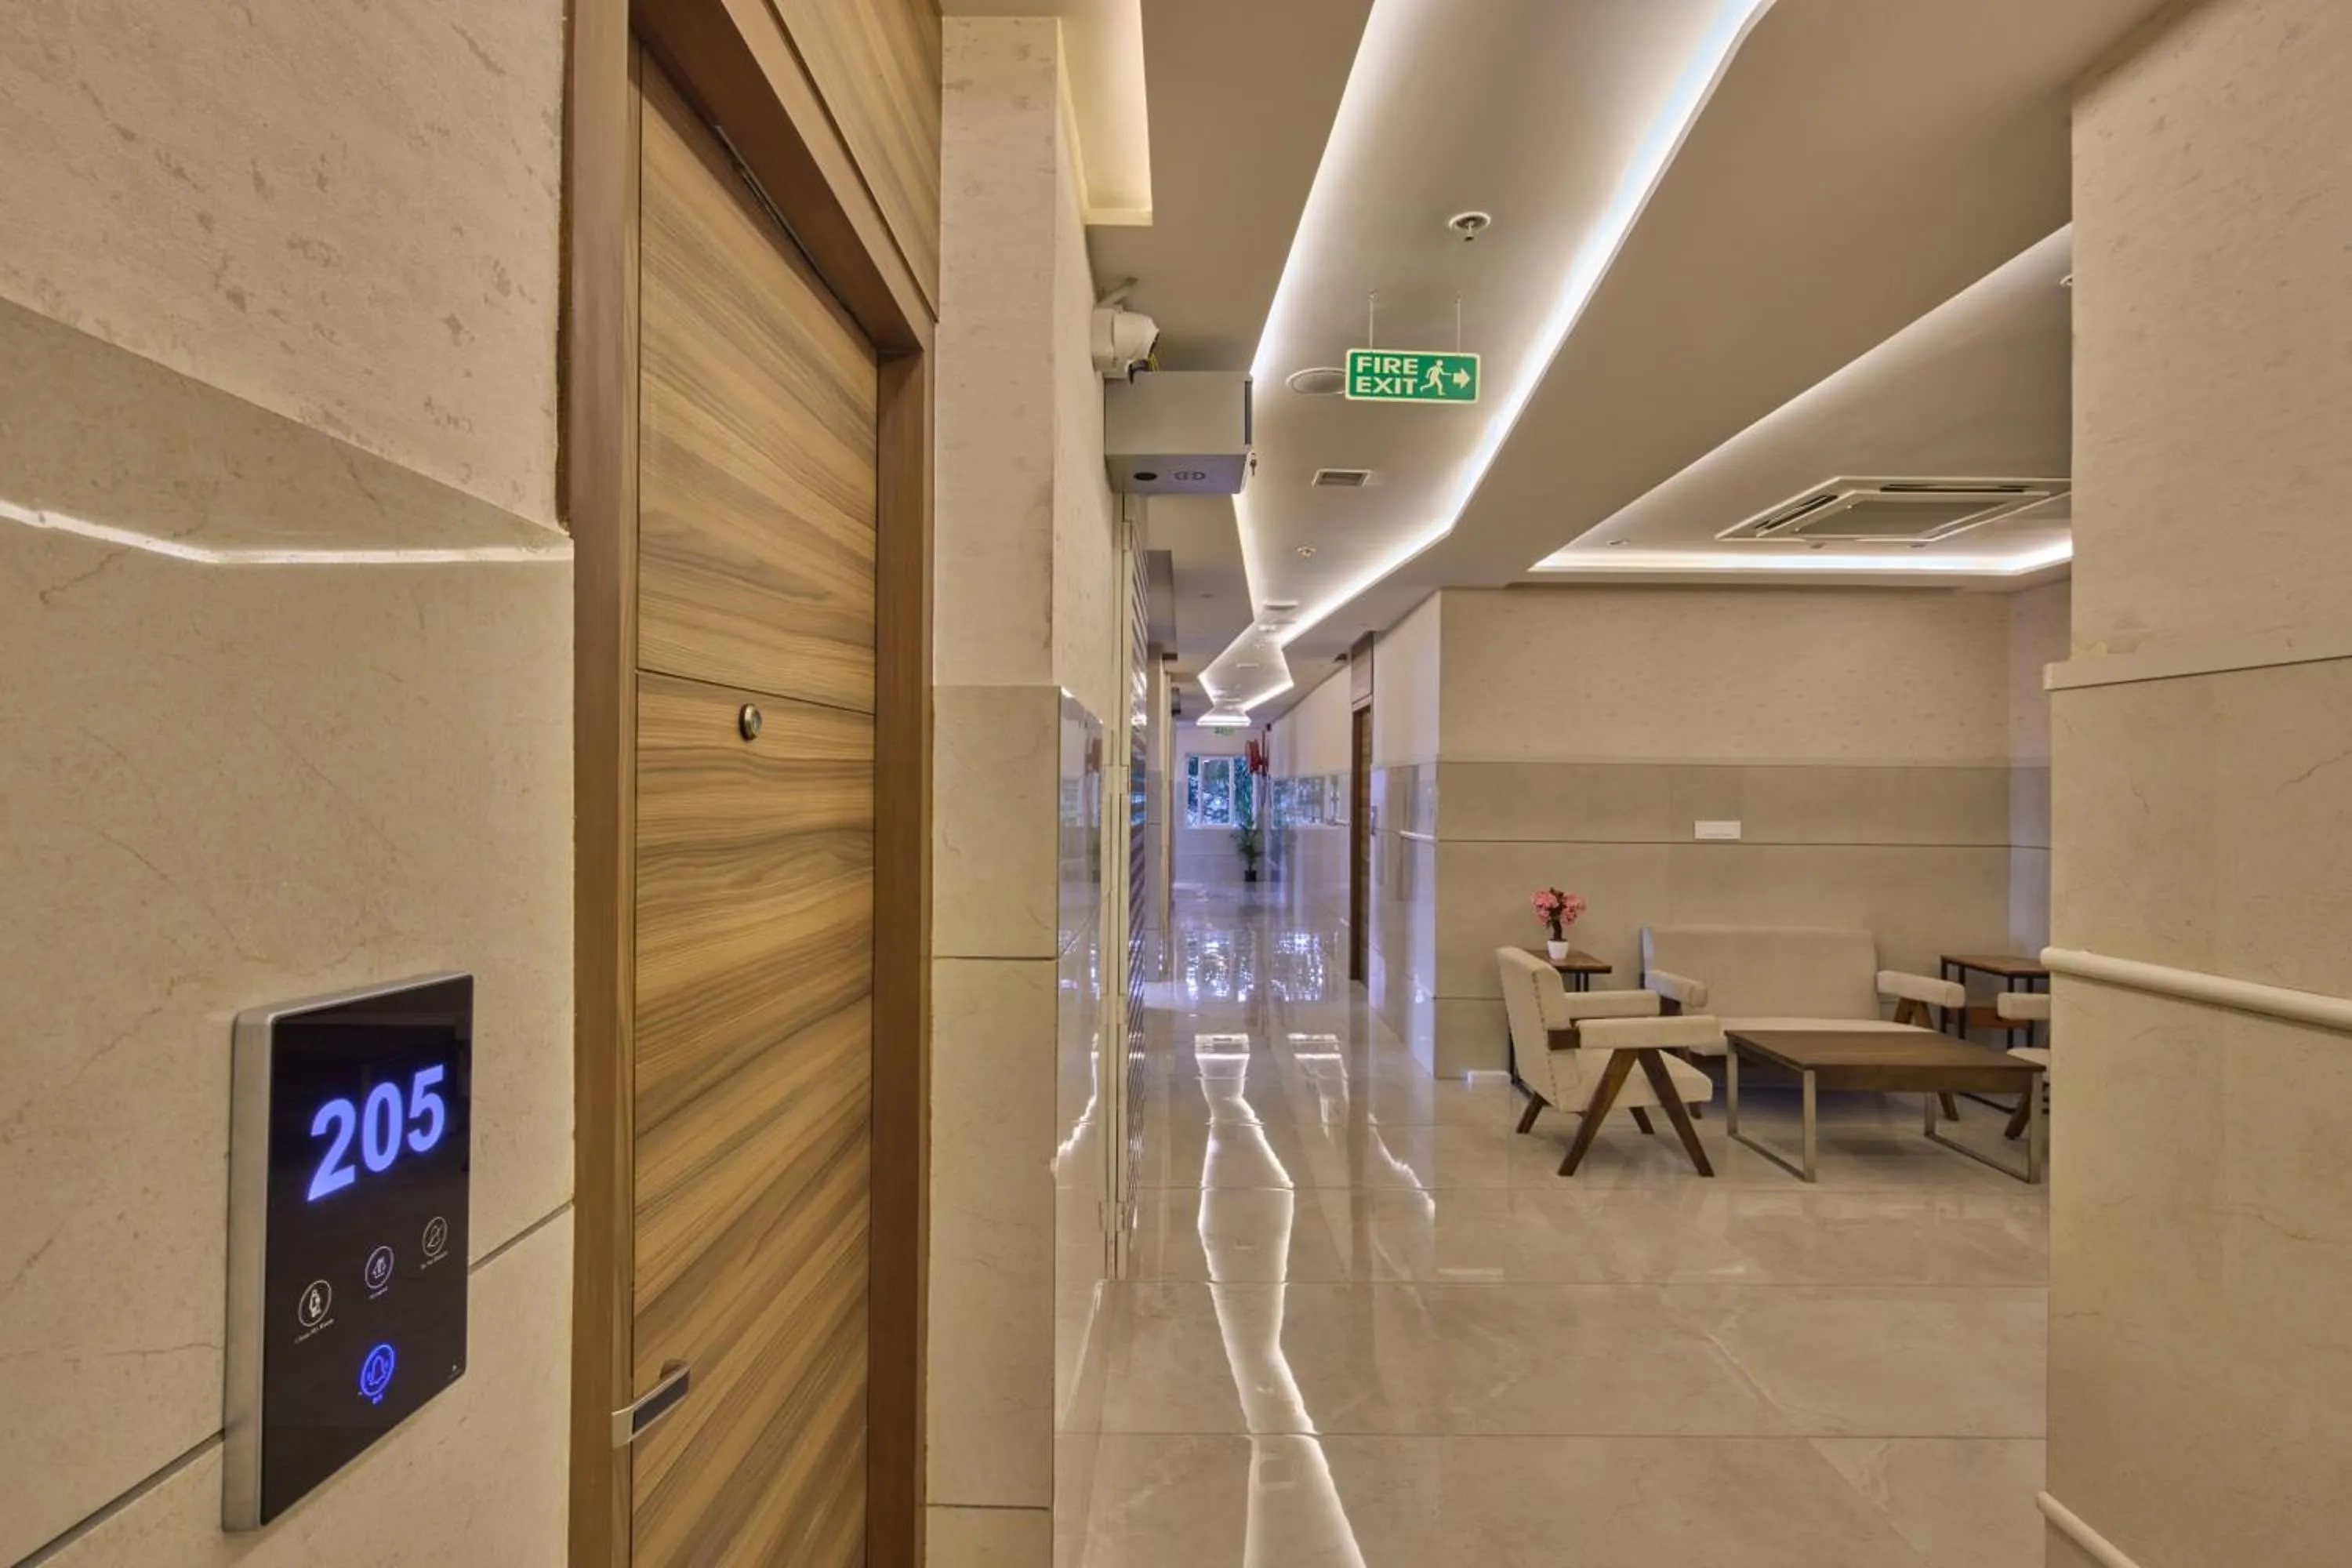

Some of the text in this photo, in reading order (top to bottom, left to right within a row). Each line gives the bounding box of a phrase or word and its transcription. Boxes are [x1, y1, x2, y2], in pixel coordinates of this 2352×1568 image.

[1357, 357, 1418, 375] FIRE
[1356, 376, 1418, 394] EXIT
[307, 1065, 445, 1202] 205
